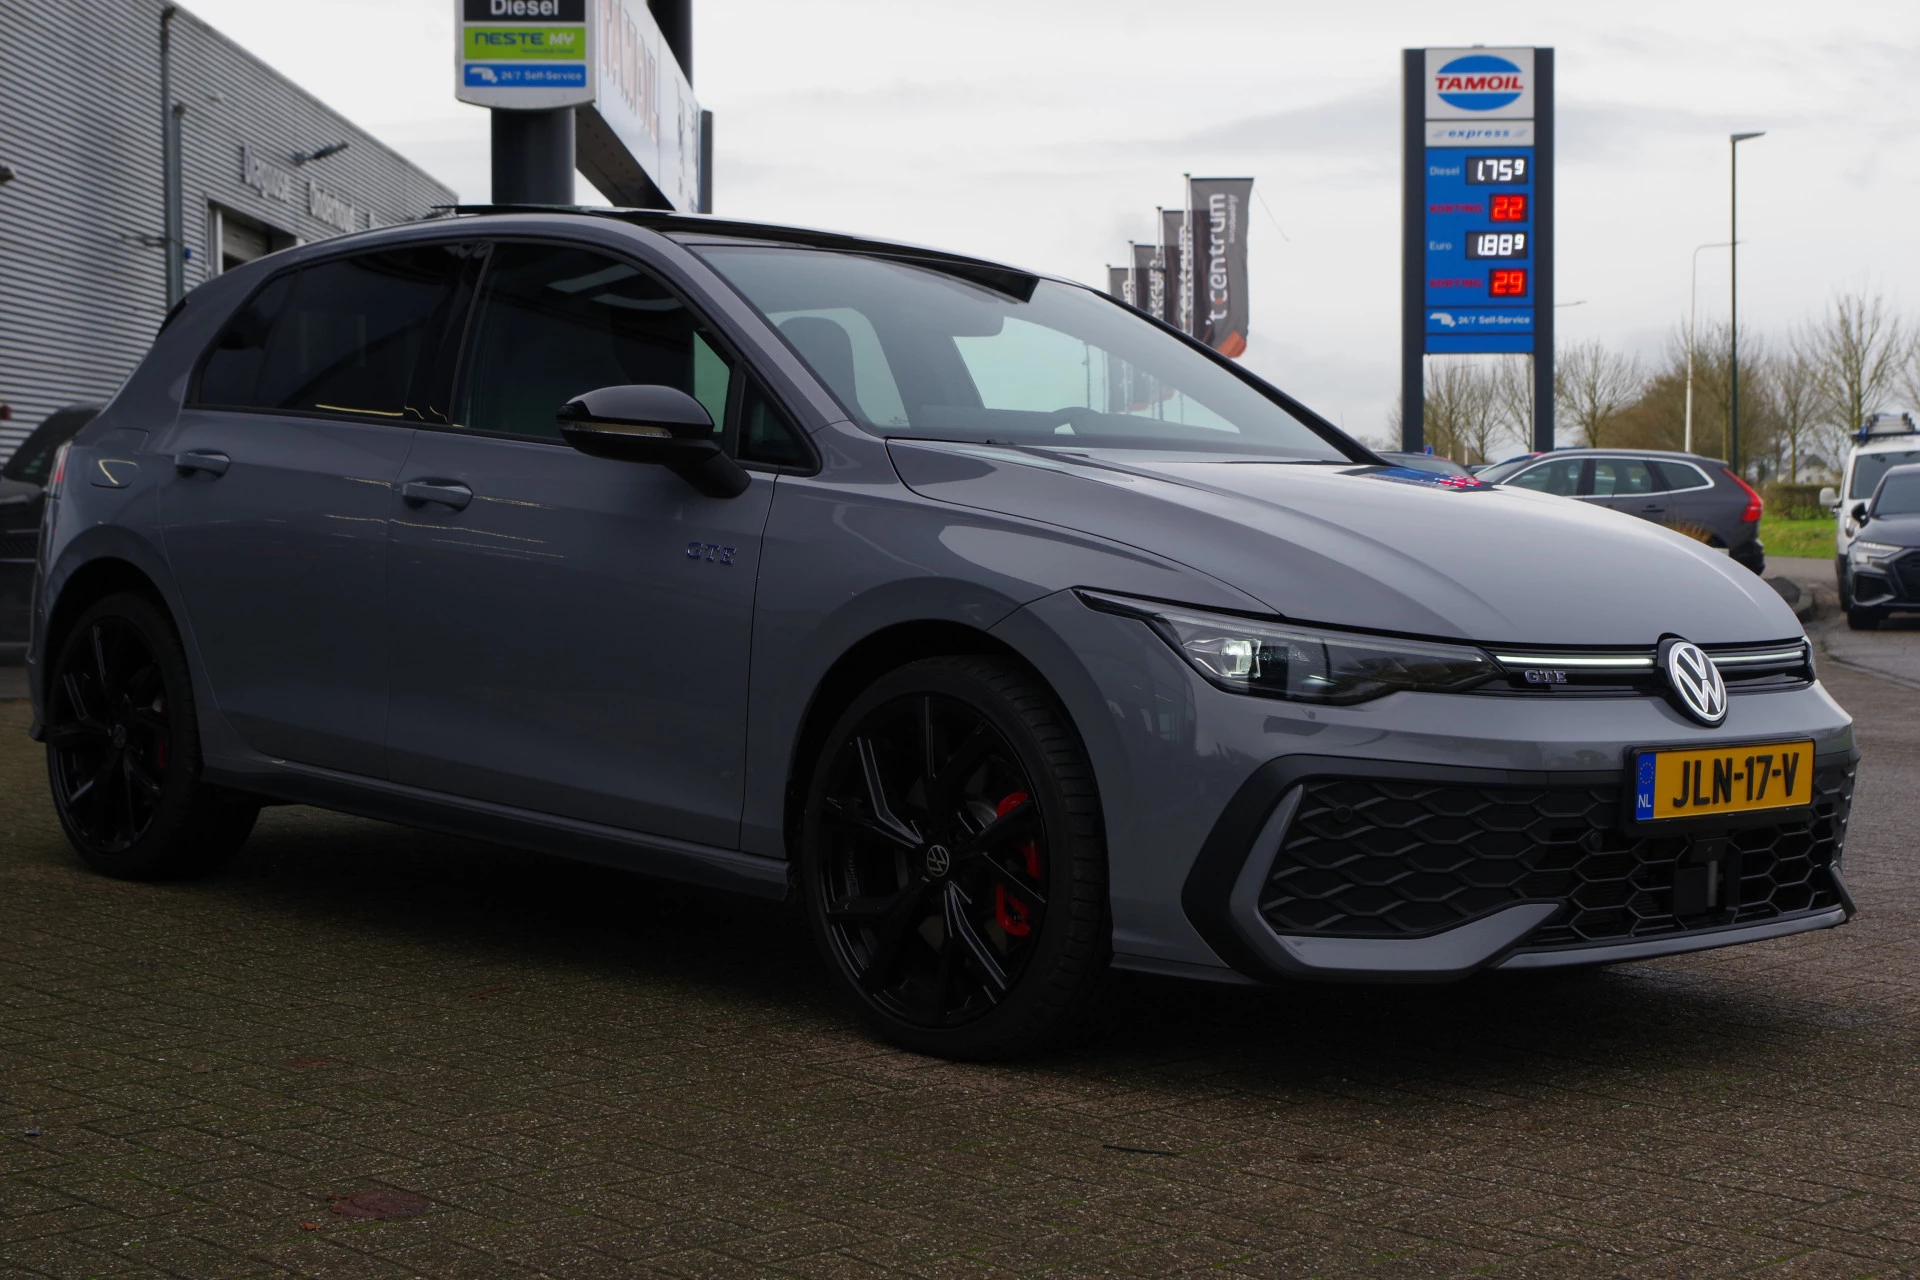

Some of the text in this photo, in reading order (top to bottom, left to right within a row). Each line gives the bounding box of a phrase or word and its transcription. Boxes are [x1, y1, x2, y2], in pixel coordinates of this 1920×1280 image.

[490, 0, 559, 16] Diesel
[474, 31, 575, 46] NESTE MY
[524, 70, 583, 81] Self-Service
[1435, 75, 1525, 91] TAMOIL
[1448, 129, 1511, 139] express
[1429, 166, 1460, 176] Diesel
[1429, 195, 1525, 220] KORTING 22
[1429, 241, 1453, 251] Euro
[1429, 270, 1524, 295] KORTING 29
[1458, 315, 1531, 325] 24/7 Self-Service
[686, 541, 737, 565] GTE
[1524, 669, 1567, 684] GTE
[1672, 752, 1800, 808] JLN-17-V
[1638, 793, 1652, 808] NL
